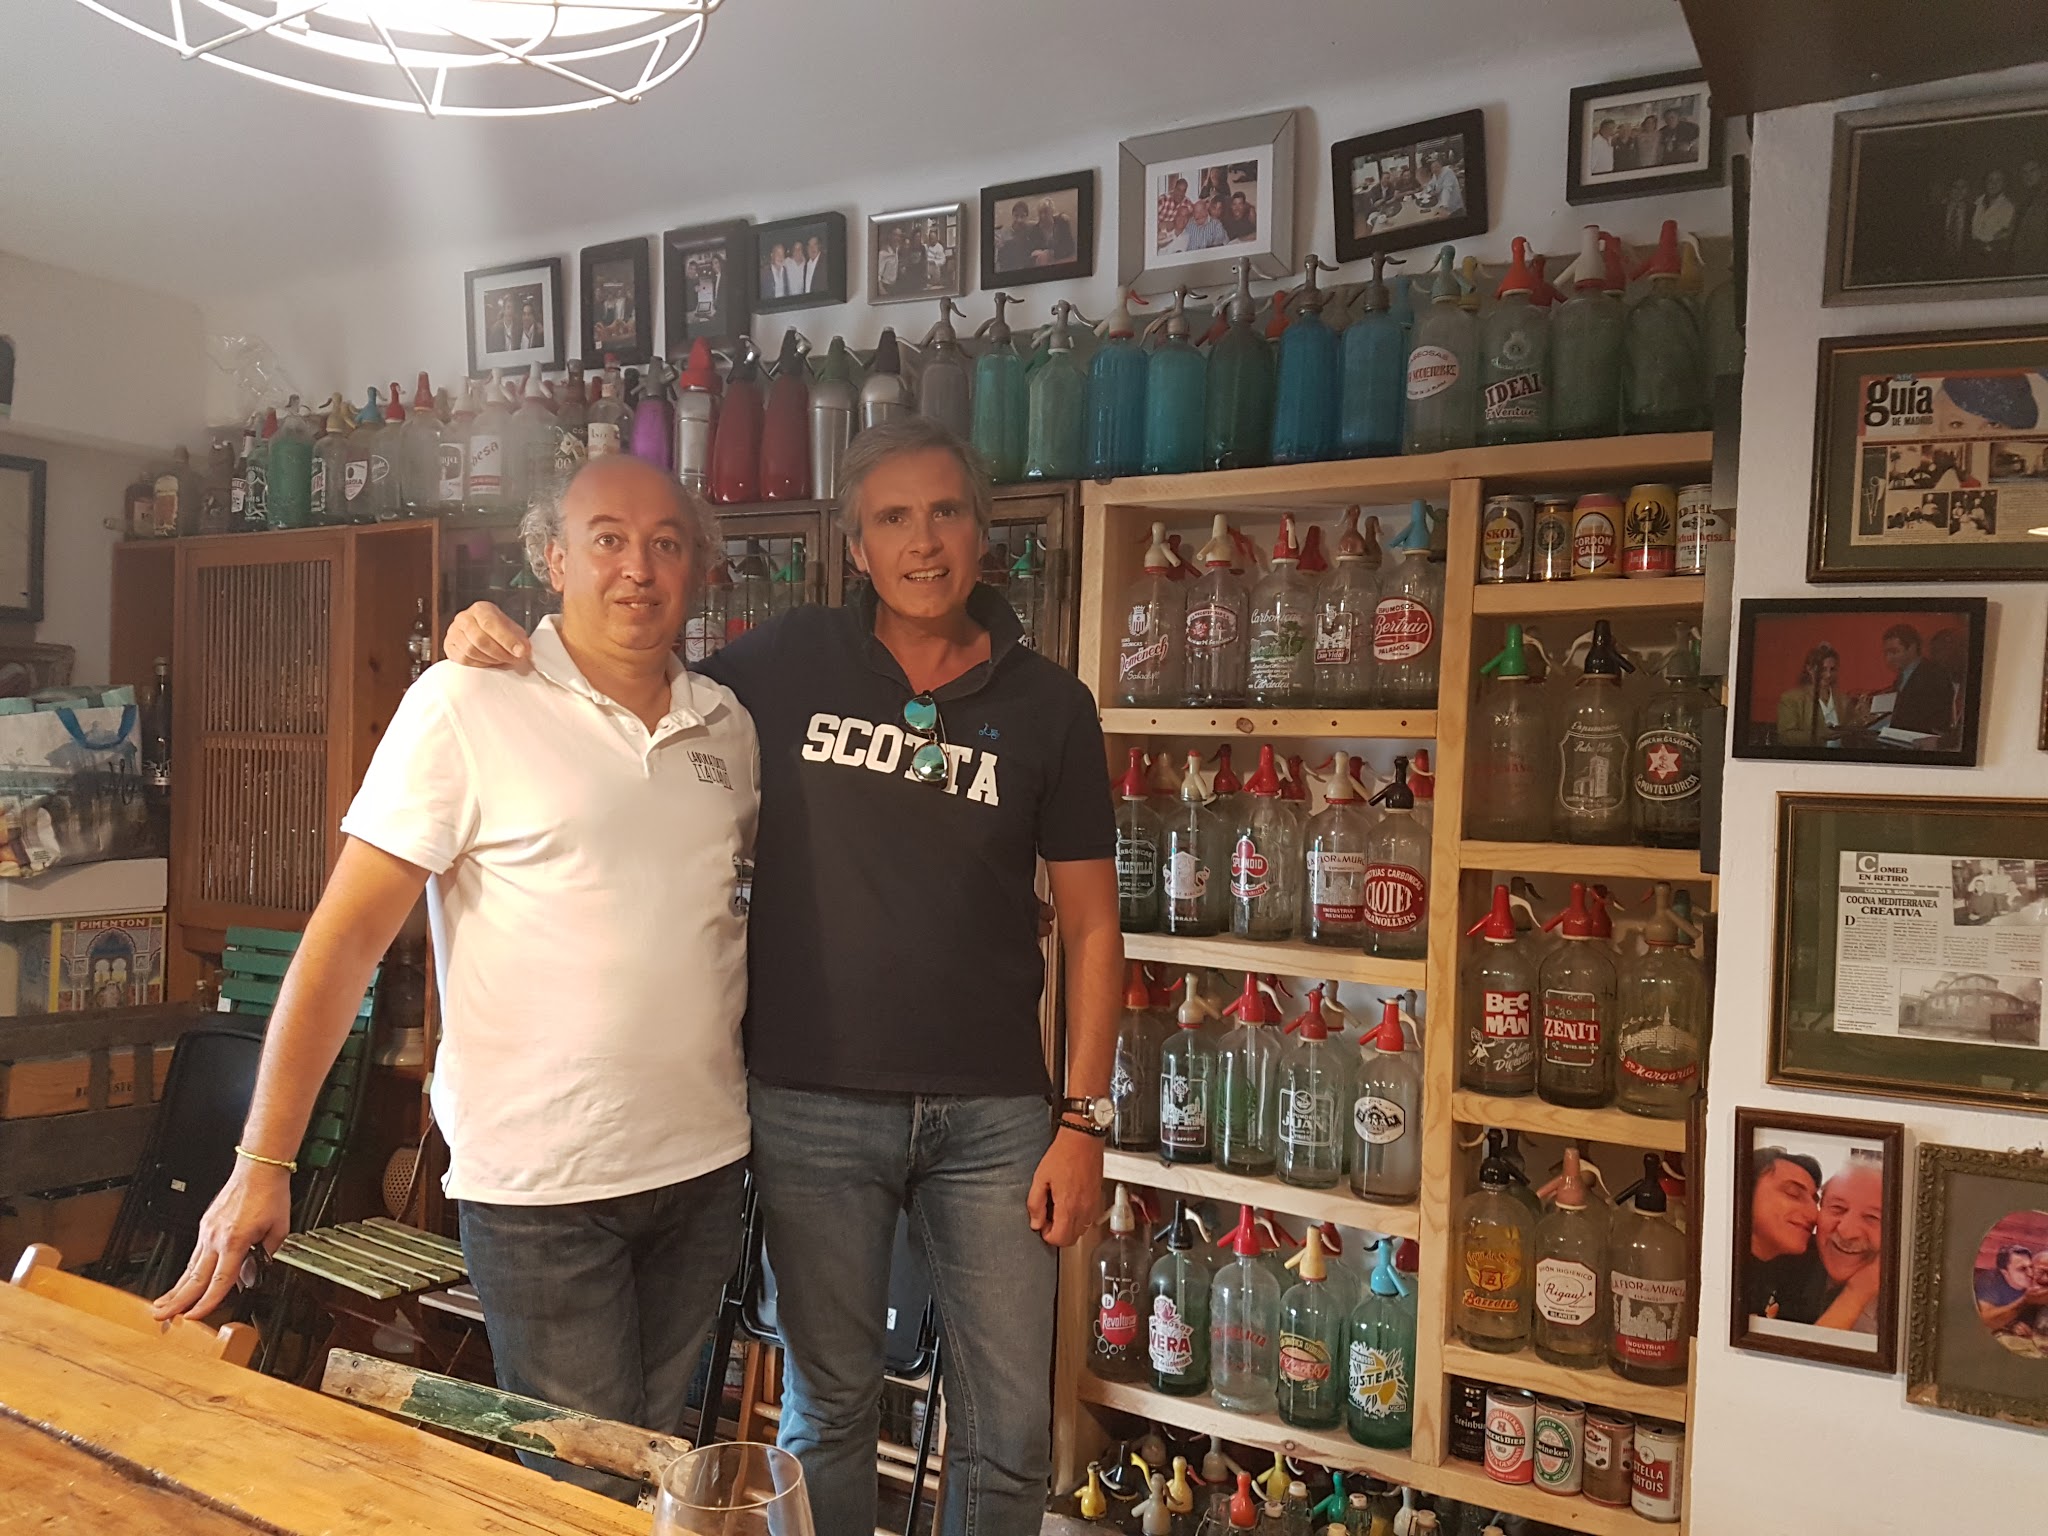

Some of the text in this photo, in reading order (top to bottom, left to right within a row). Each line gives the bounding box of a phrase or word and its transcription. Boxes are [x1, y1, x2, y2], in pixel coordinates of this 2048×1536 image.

[1864, 376, 1934, 427] guía
[1892, 415, 1933, 426] DE MADRID
[1486, 528, 1517, 540] SKOL
[1574, 536, 1612, 548] CORDON
[1375, 614, 1429, 637] Bertrán
[1232, 857, 1263, 869] SPLNDID
[1316, 855, 1337, 865] LOR
[1858, 873, 1909, 882] EN RETIRO
[1366, 880, 1413, 915] CLOTET
[1846, 895, 1938, 908] COCINA MEDITERRANEA
[1364, 907, 1417, 927] GRANOLLERS
[1861, 905, 1923, 917] CREATIVA
[80, 918, 146, 930] PIMENTON
[1168, 914, 1198, 922] TRRASA
[1485, 992, 1530, 1014] BEC
[1485, 1013, 1530, 1036] MAN
[1544, 1018, 1599, 1041] ZENIT
[1281, 1113, 1327, 1133] JUAN
[1150, 1330, 1191, 1354] VERA
[1625, 1339, 1666, 1351] INDUSTRIAS
[1627, 1347, 1662, 1357] REUNIDAS
[1634, 1461, 1664, 1480] STELLA
[1633, 1474, 1664, 1493] ARTOIS
